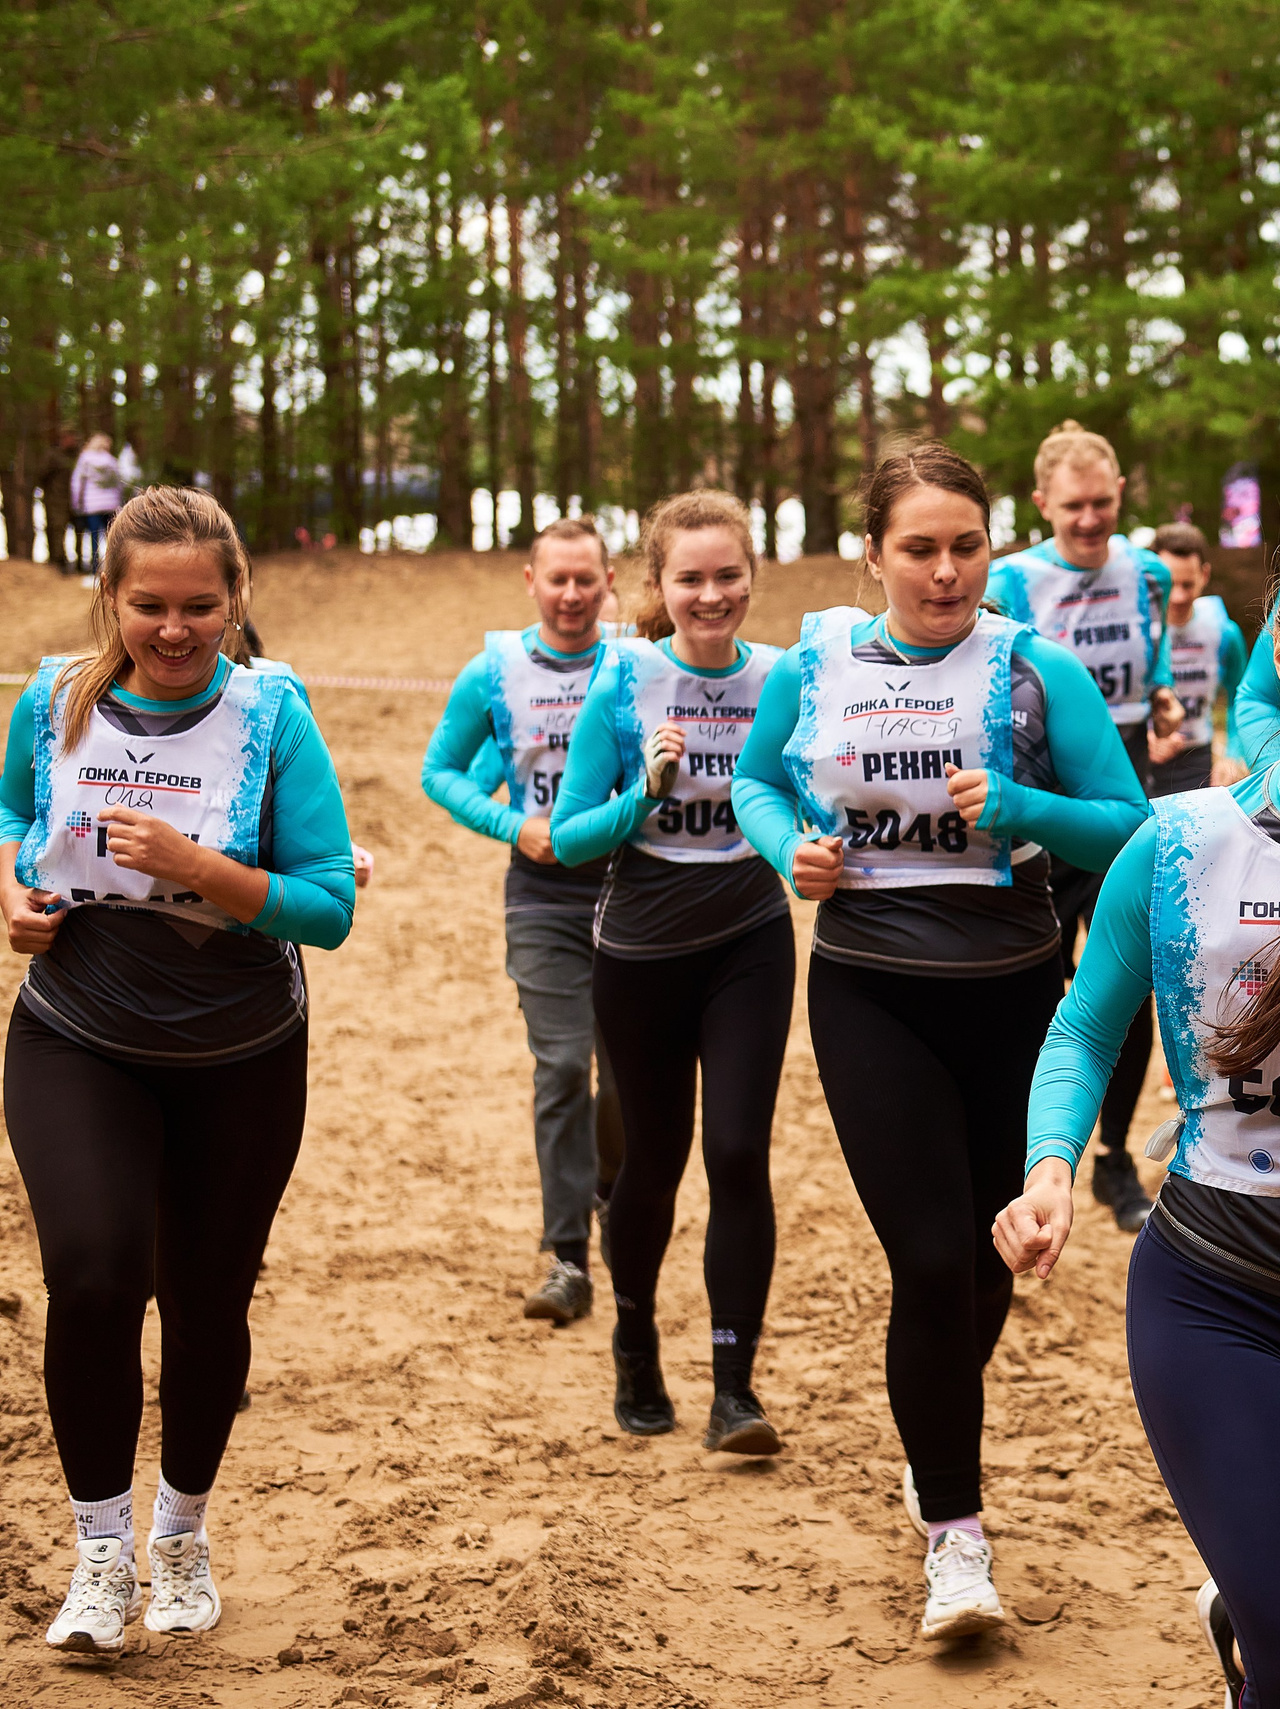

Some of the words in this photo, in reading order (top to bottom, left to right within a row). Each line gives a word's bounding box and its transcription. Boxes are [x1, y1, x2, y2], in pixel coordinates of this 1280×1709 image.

[666, 706, 709, 718] ГОНКА
[842, 697, 889, 718] ГОНКА
[894, 696, 955, 712] ГЕРОЕВ
[688, 752, 739, 778] РЕХ
[78, 767, 129, 783] ГОНКА
[134, 770, 202, 789] ГЕРОЕВ
[657, 796, 738, 837] 504
[844, 806, 969, 854] 5048
